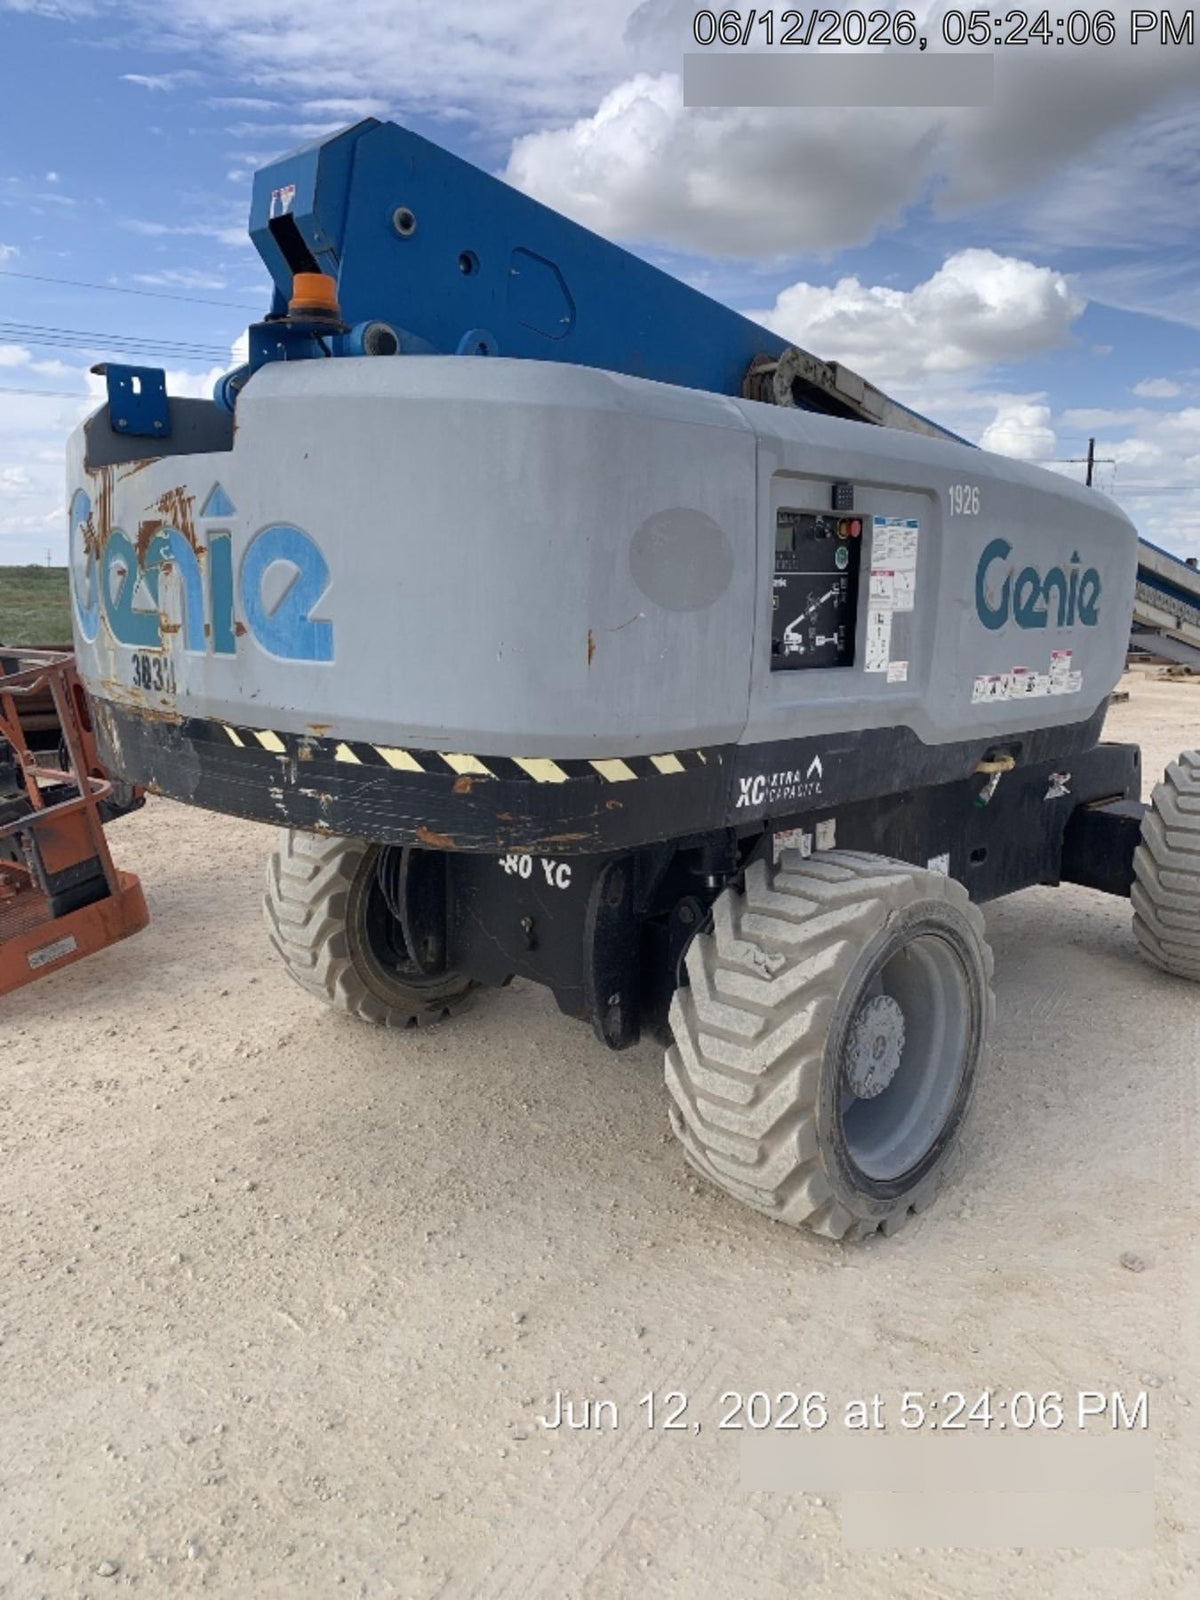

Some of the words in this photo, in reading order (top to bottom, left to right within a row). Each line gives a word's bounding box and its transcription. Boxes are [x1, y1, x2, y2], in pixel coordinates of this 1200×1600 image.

[949, 484, 980, 516] 1926
[975, 538, 1102, 630] Genie
[735, 774, 766, 808] XC
